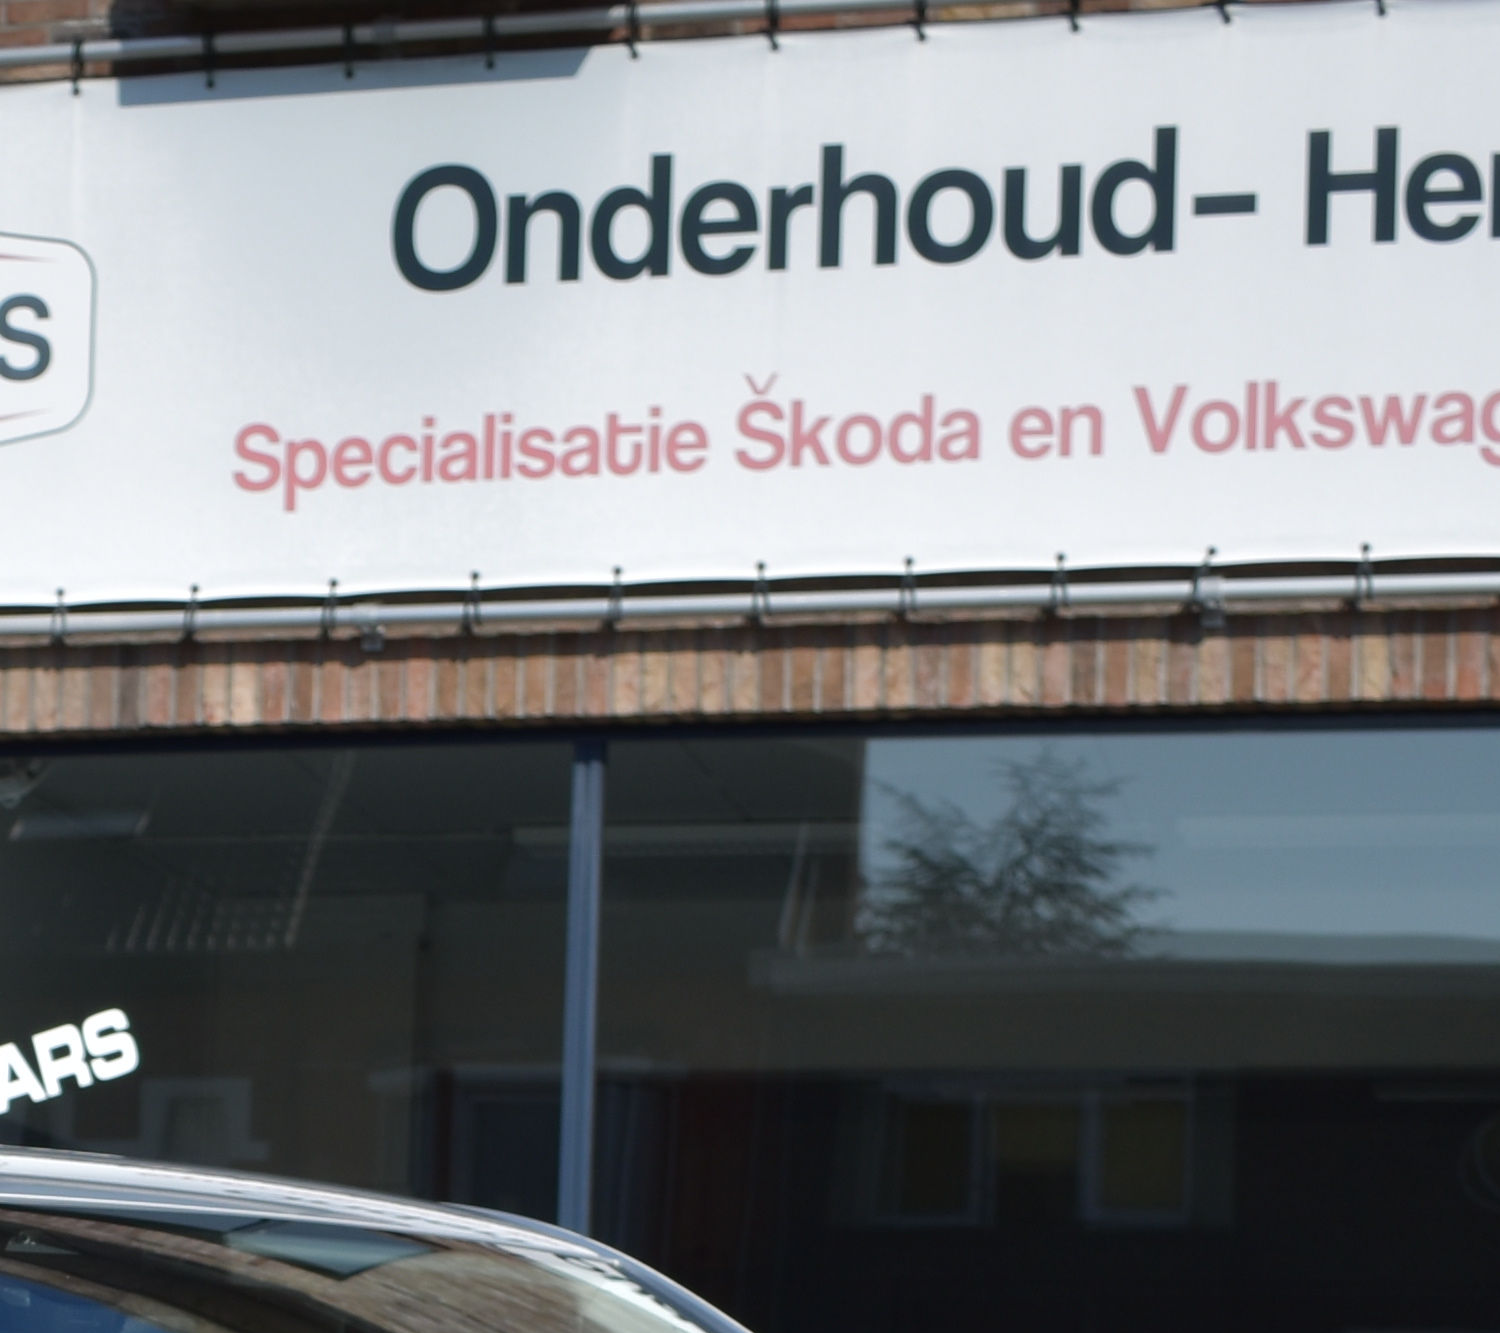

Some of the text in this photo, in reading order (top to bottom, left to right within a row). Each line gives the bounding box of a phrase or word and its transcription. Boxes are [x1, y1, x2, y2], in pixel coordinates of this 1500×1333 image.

[233, 413, 710, 513] Specialisatie
[735, 373, 981, 473] Škoda
[1009, 405, 1104, 461] en
